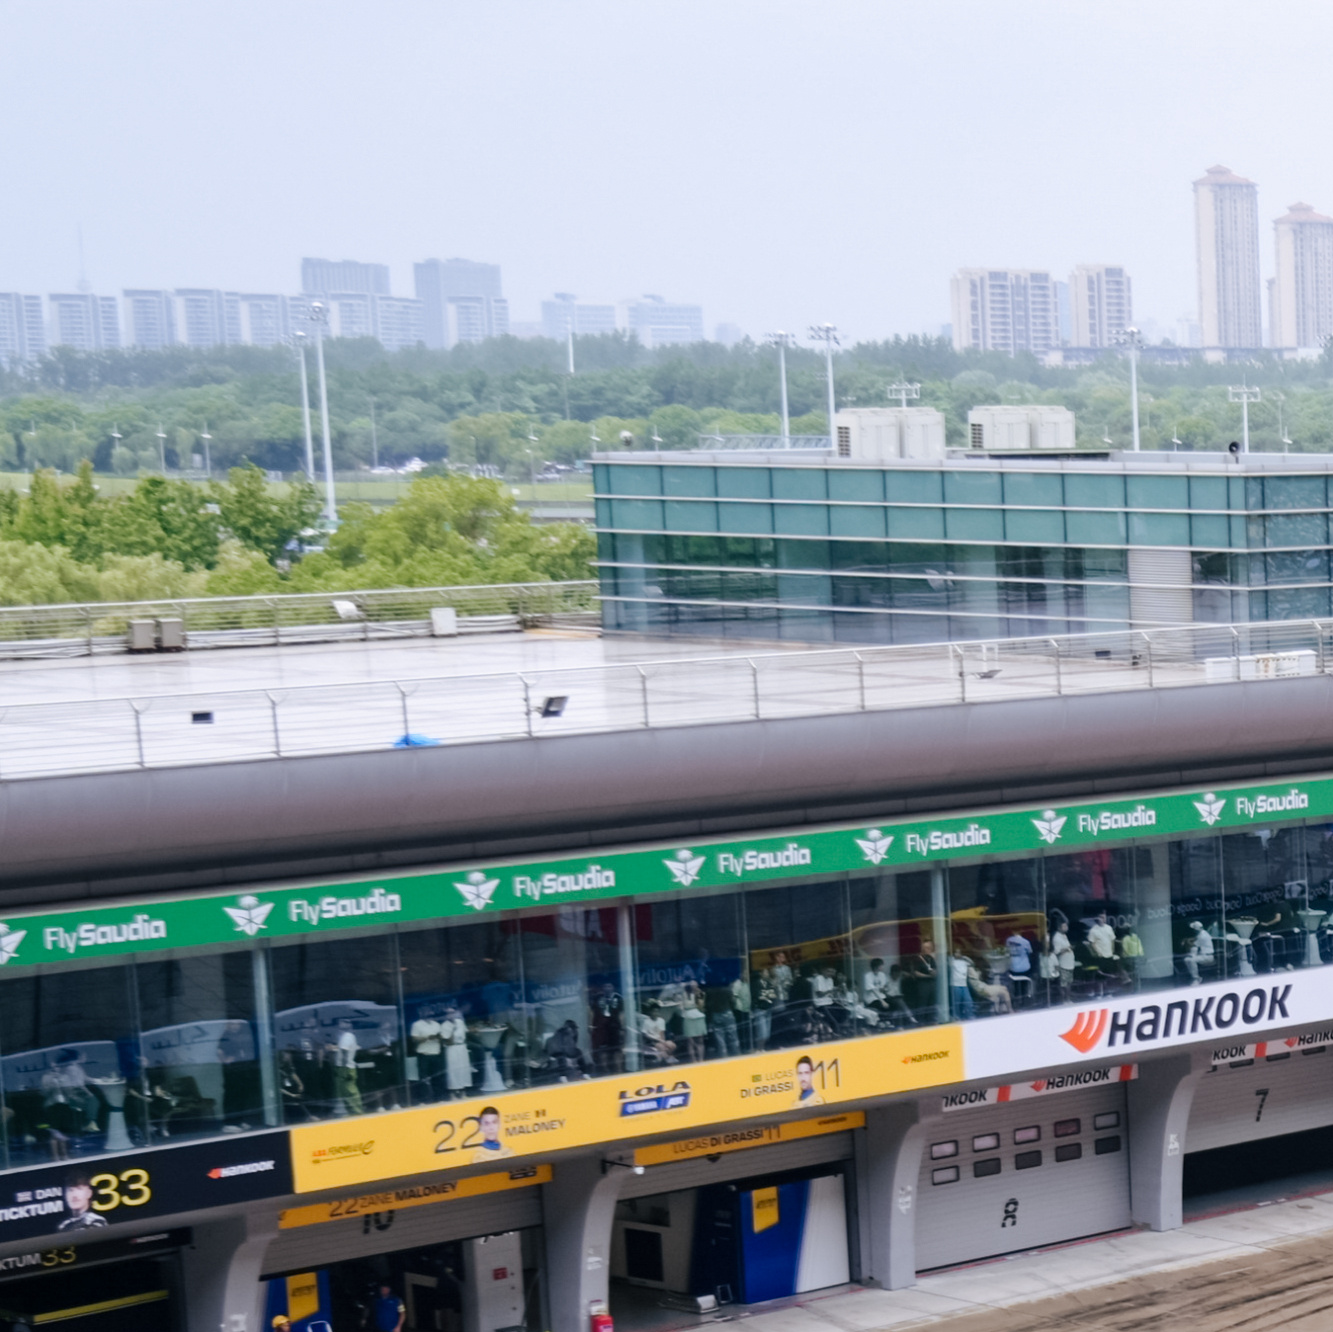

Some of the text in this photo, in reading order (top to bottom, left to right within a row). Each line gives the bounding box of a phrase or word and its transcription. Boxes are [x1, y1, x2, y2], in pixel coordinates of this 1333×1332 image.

[618, 1080, 691, 1100] LOLA
[740, 1081, 794, 1099] DI GRASSI
[1255, 1088, 1270, 1122] 7
[504, 1111, 531, 1123] ZANE
[505, 1118, 566, 1137] MALONEY
[433, 1116, 482, 1154] 22
[673, 1138, 709, 1154] LUCAS
[710, 1136, 722, 1147] DI
[724, 1129, 763, 1145] GRASSI
[35, 1187, 62, 1200] DAN
[90, 1169, 151, 1212] 33
[360, 1193, 392, 1209] ZANE
[395, 1182, 458, 1201] MALONEY
